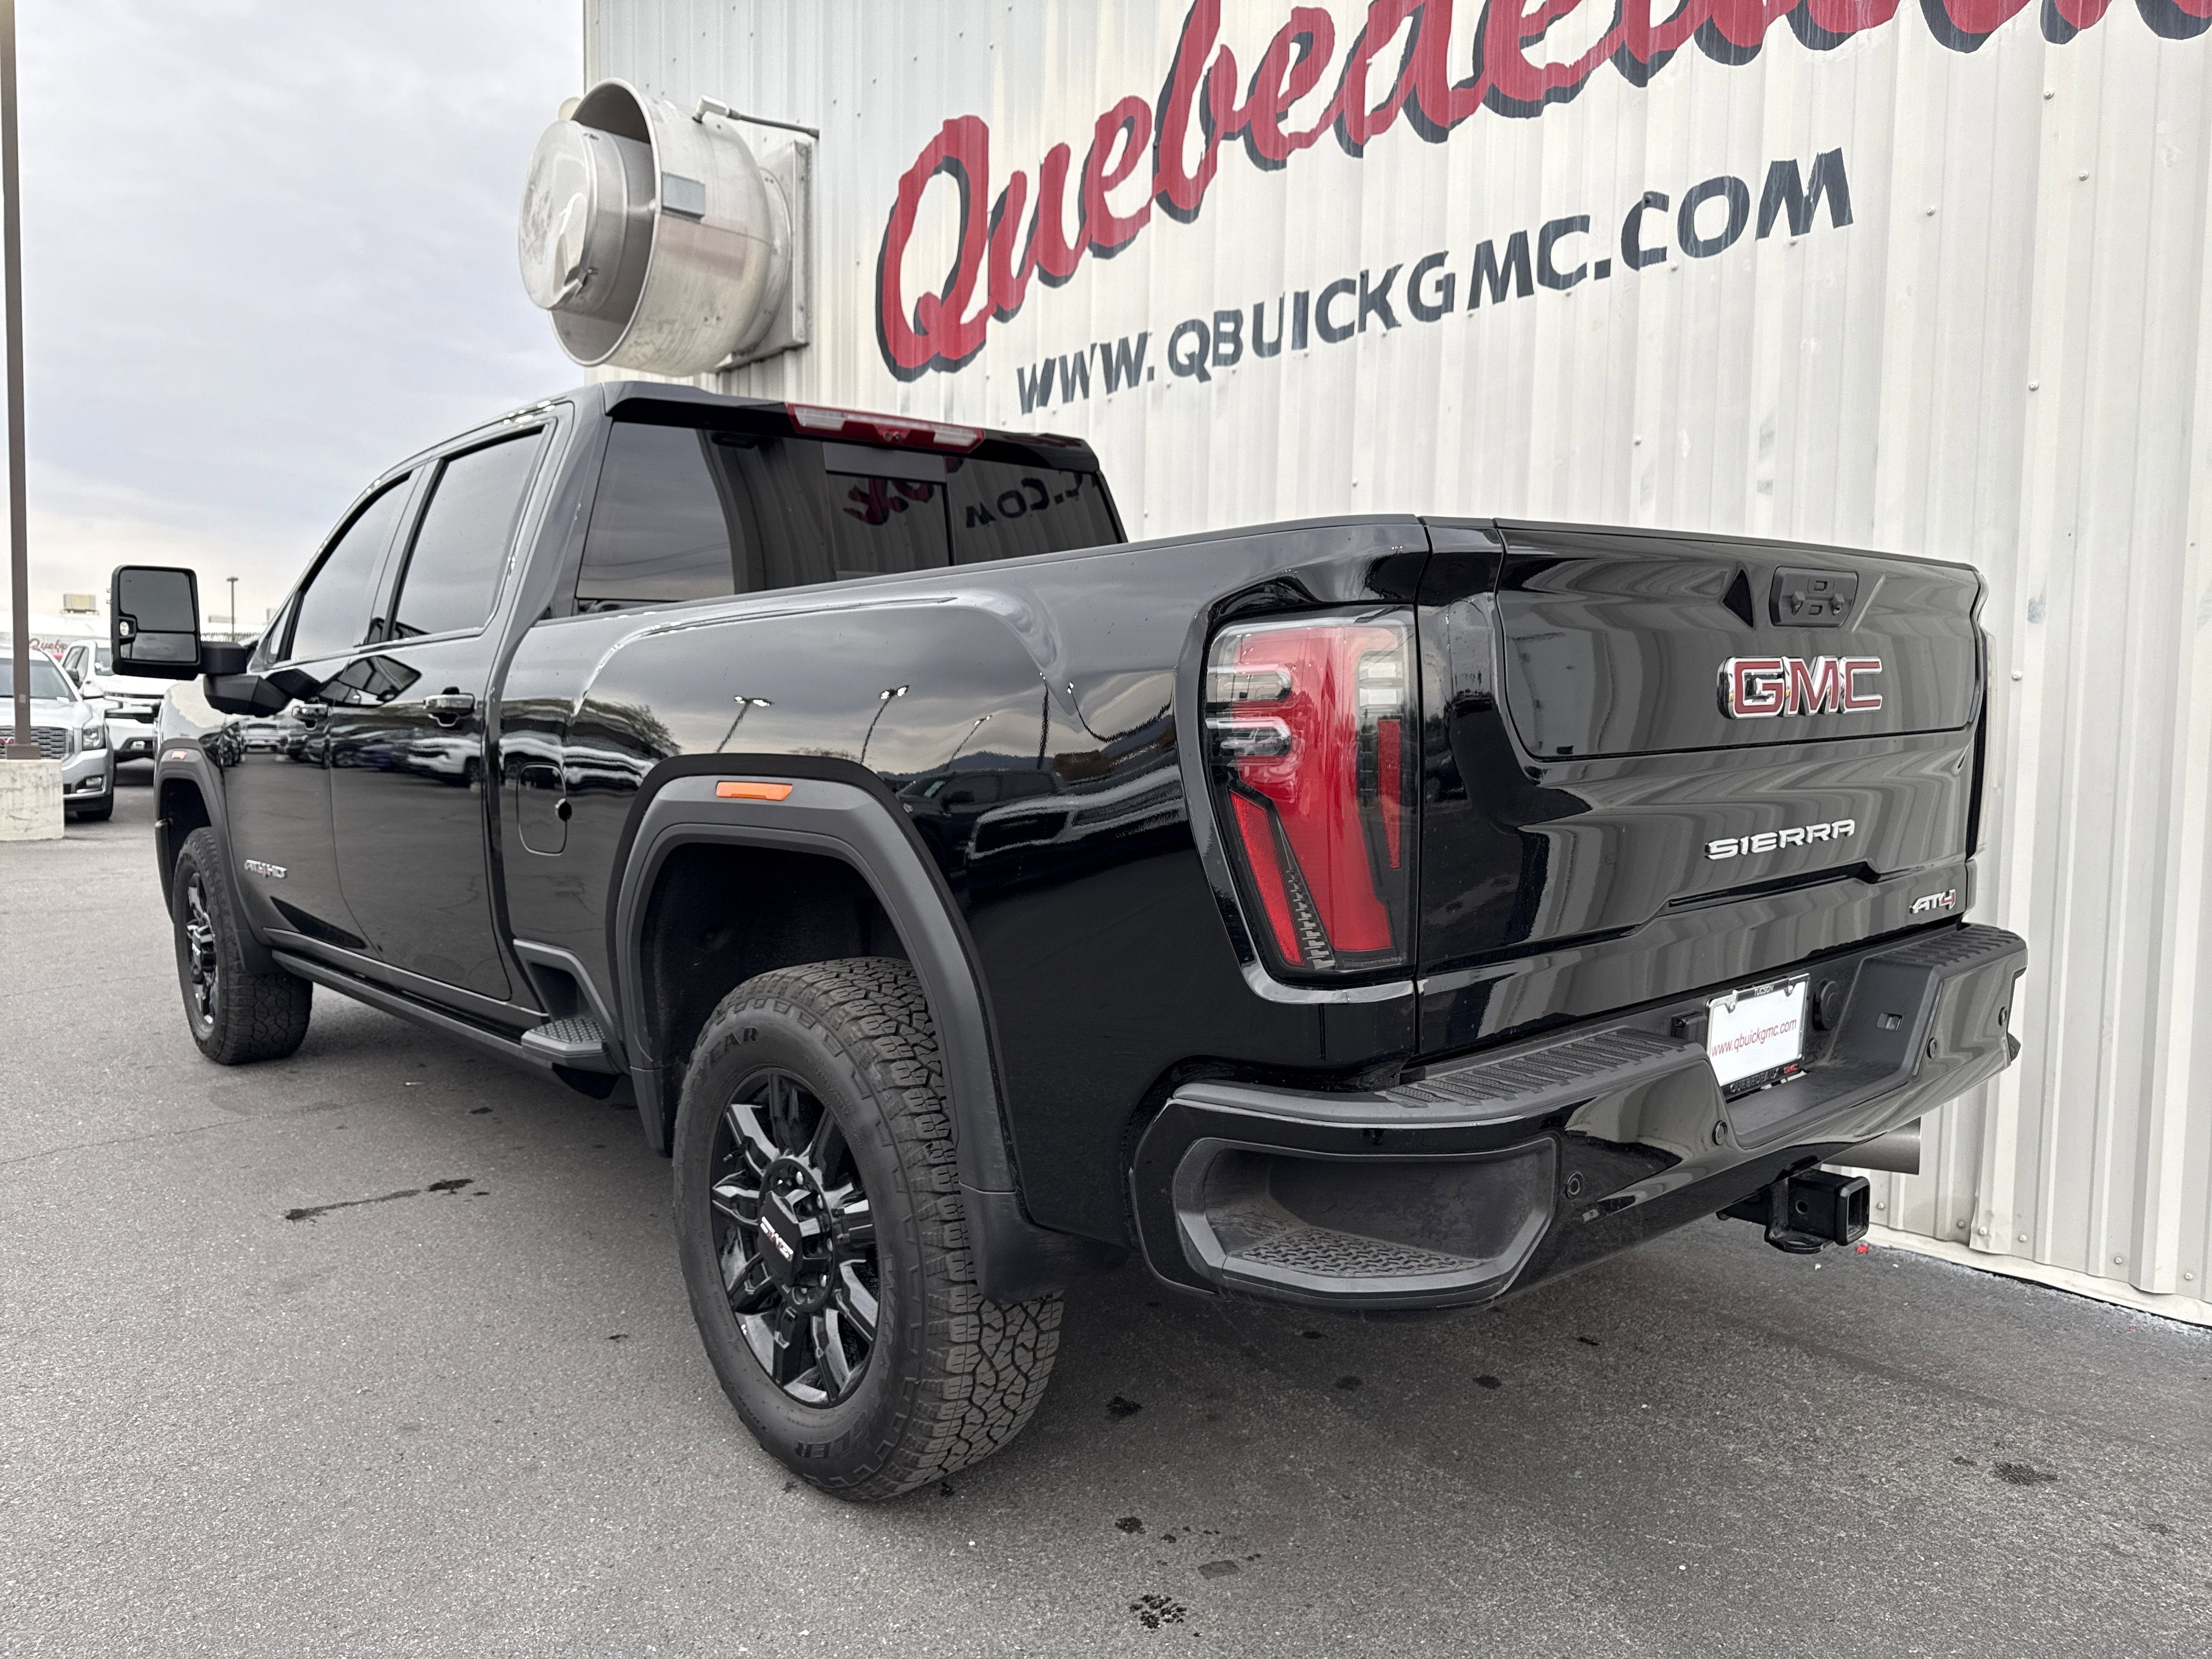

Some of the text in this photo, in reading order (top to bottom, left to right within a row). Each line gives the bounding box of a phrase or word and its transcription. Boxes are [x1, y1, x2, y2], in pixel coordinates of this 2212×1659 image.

[876, 0, 2212, 382] Quebede
[1017, 147, 1853, 415] WWW.QBUICKGMC.COM
[1717, 656, 1882, 720] GMC
[1705, 819, 1855, 860] SIERRA
[1909, 888, 1956, 915] AT4
[1754, 984, 1774, 996] TUCSON
[1711, 1019, 1797, 1057] www.qbuickgmc.com
